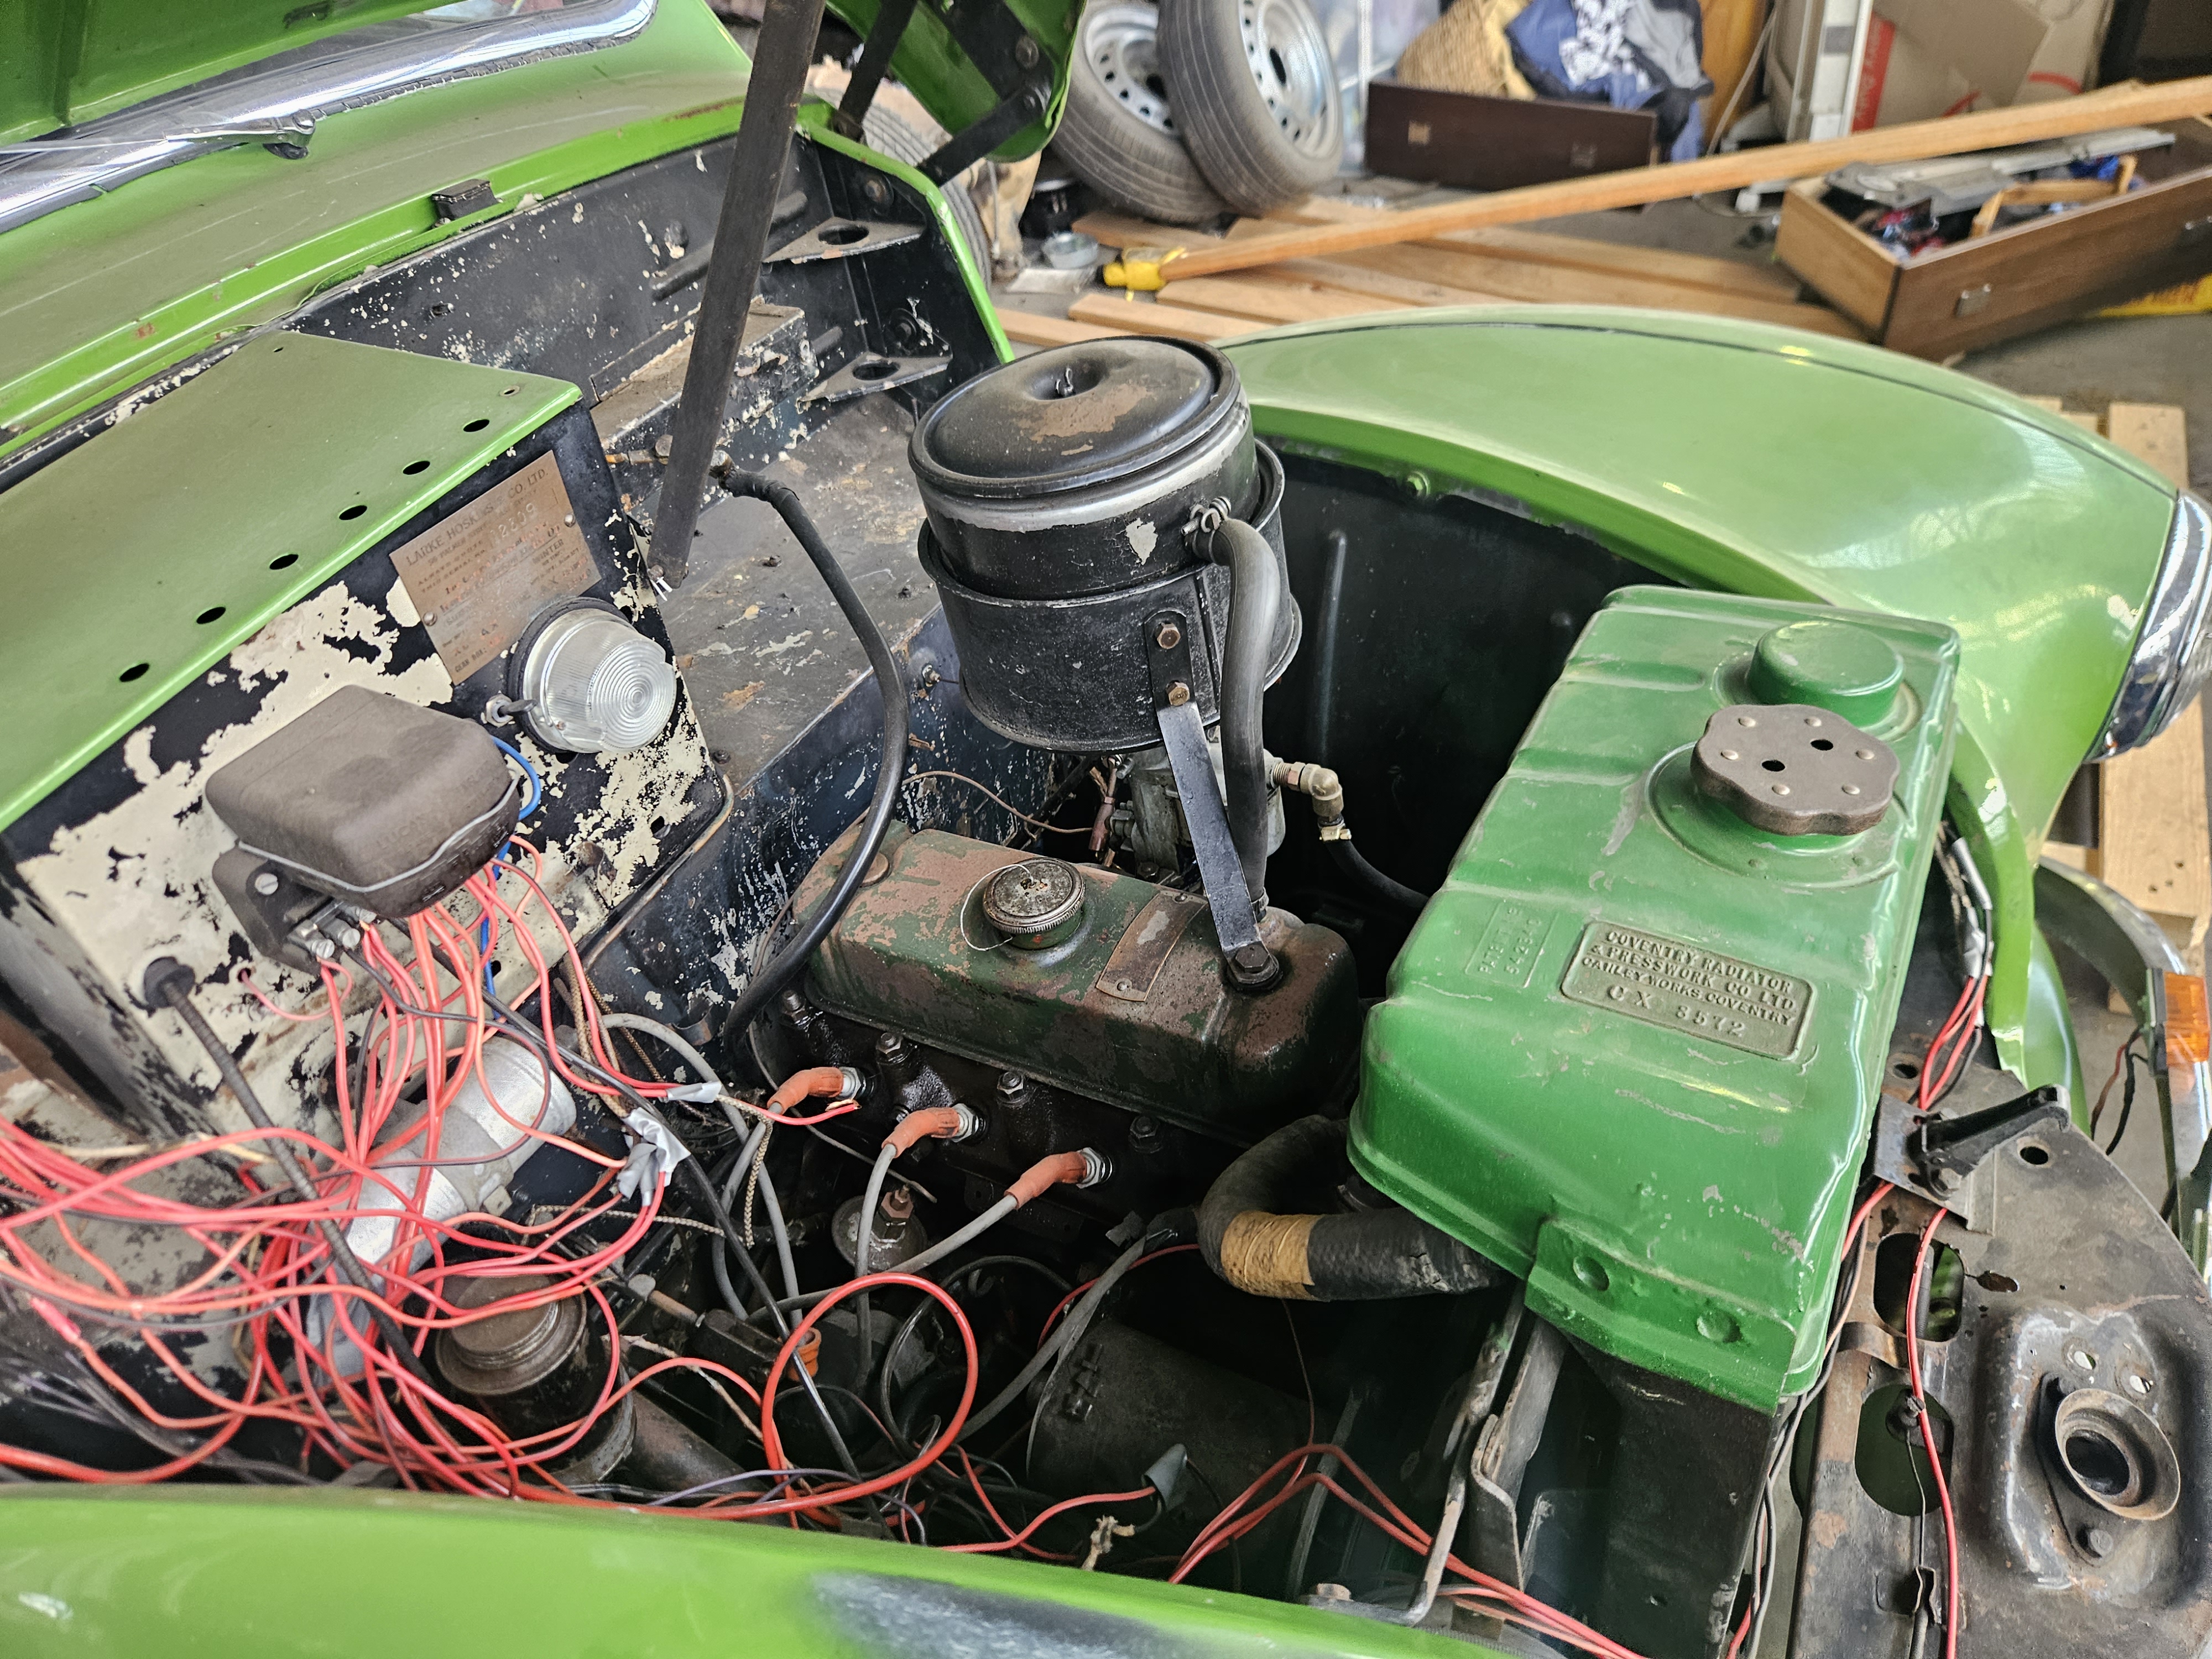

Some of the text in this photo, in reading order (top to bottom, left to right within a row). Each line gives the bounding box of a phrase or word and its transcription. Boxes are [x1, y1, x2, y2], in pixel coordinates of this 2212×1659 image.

[1590, 943, 1605, 955] &
[1606, 947, 1717, 988] PRESSWORK
[1724, 982, 1752, 999] CO
[1605, 930, 1793, 994] COVENTRY RADIATOR
